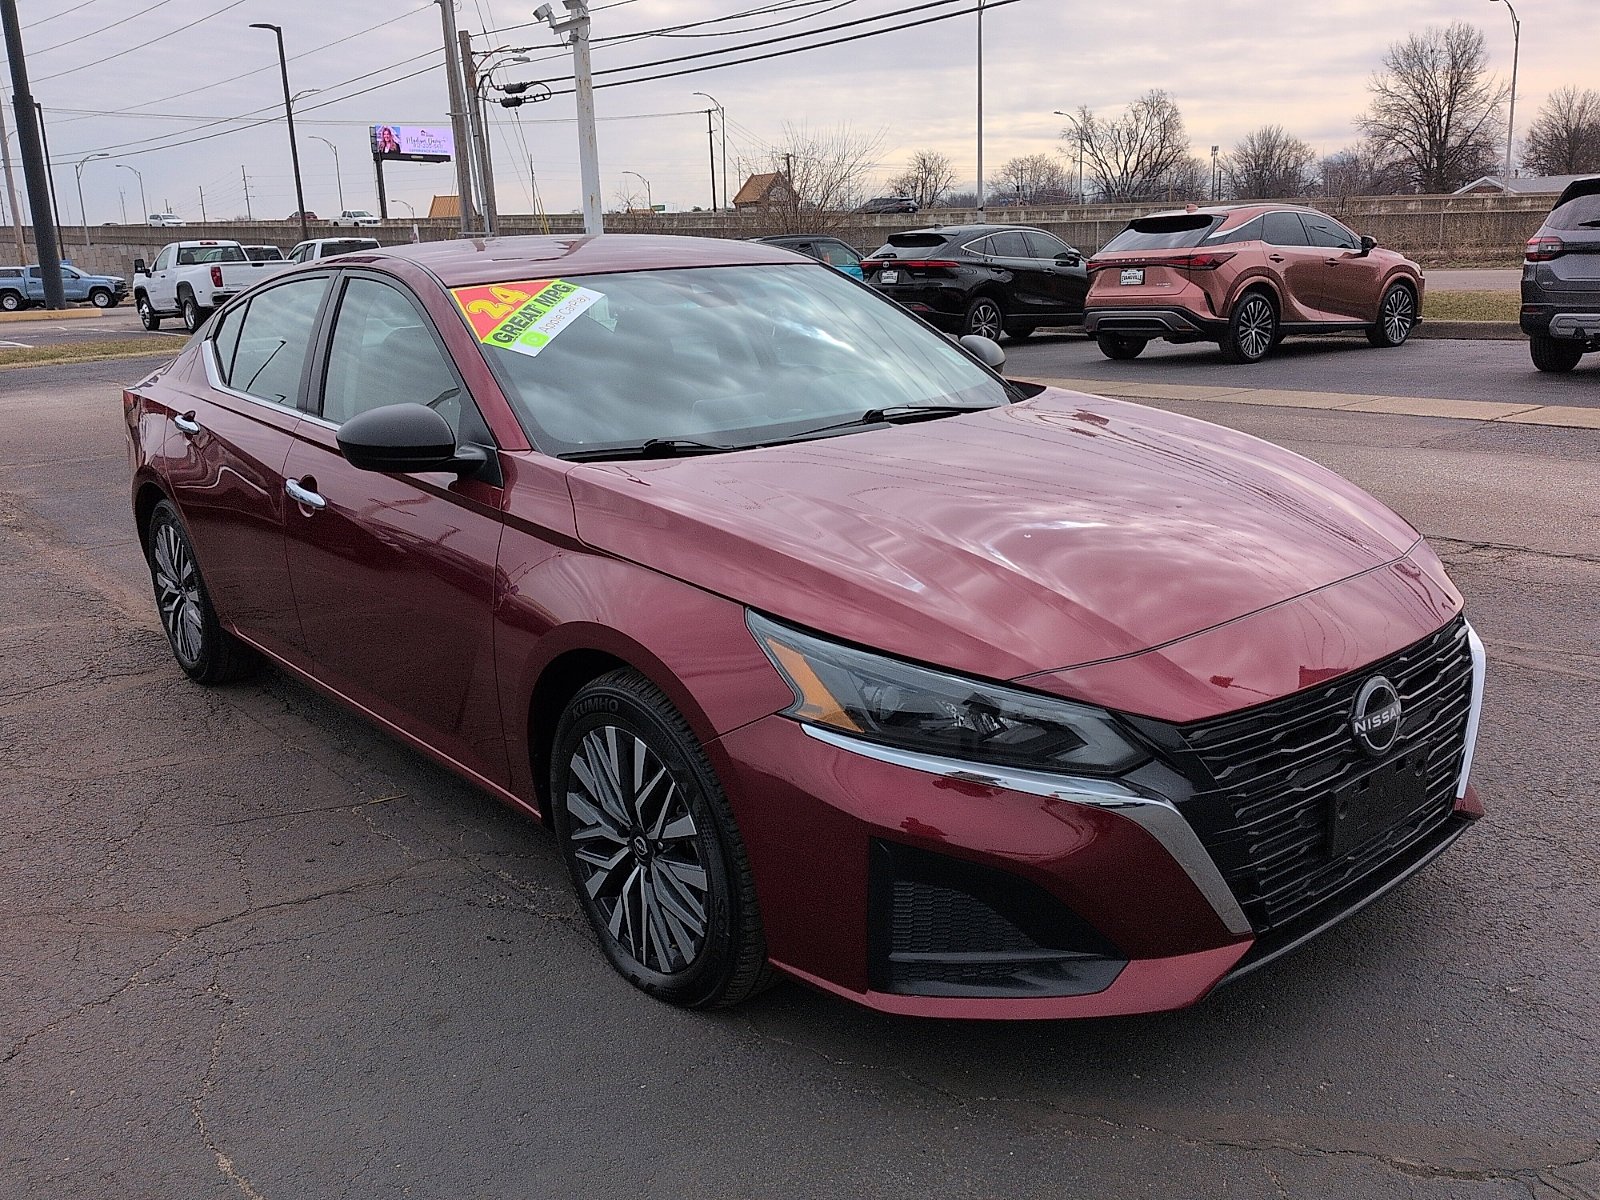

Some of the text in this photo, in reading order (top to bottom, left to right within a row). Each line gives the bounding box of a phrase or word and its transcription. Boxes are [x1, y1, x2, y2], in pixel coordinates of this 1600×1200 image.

[466, 286, 531, 320] 24
[492, 284, 572, 343] GREAT MPG
[538, 294, 590, 334] Apple CarPlay
[572, 697, 619, 720] KUMHO
[1354, 704, 1401, 733] NISSAN
